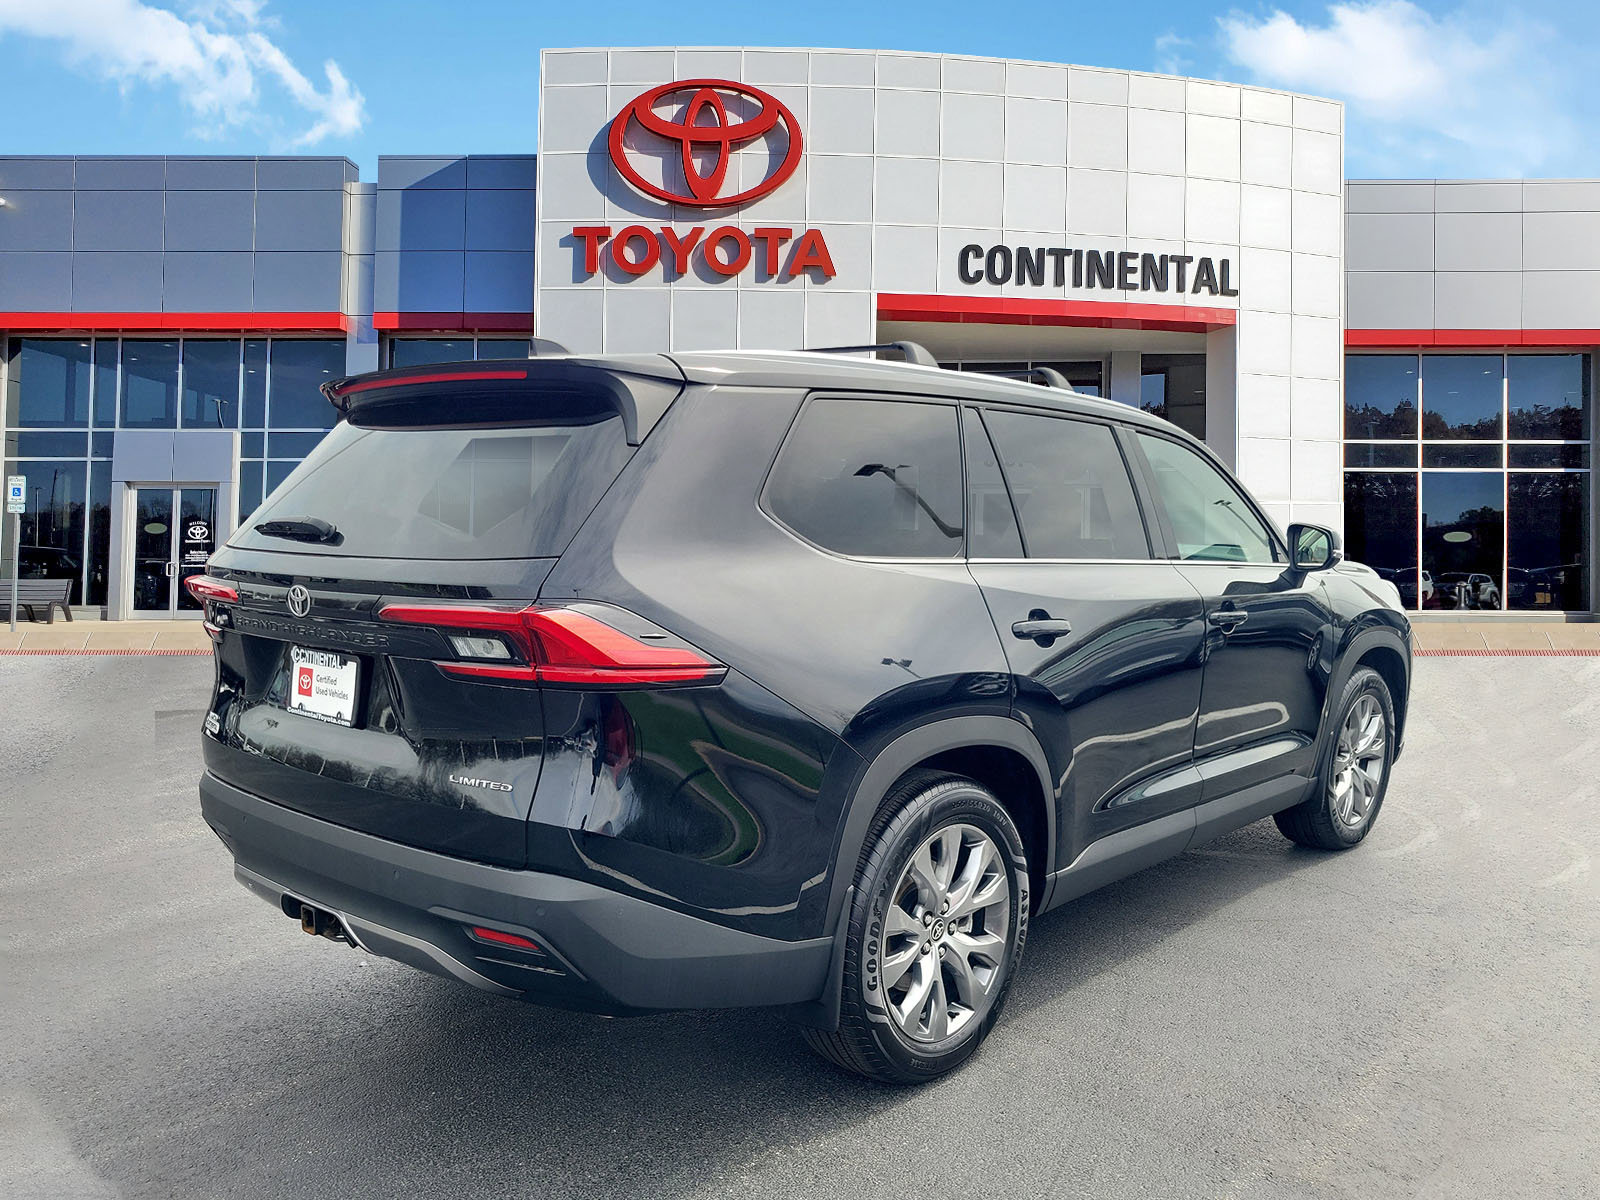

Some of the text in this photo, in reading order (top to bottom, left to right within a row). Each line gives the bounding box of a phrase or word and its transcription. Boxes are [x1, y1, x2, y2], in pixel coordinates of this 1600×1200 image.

[573, 225, 837, 277] TOYOTA
[958, 244, 1239, 297] CONTINENTAL
[281, 621, 392, 648] HIGHLANDER
[315, 674, 338, 686] Certified
[315, 686, 349, 701] Used Vehicles
[286, 706, 351, 728] ContinentalToyota.com
[448, 774, 514, 792] LIMITED
